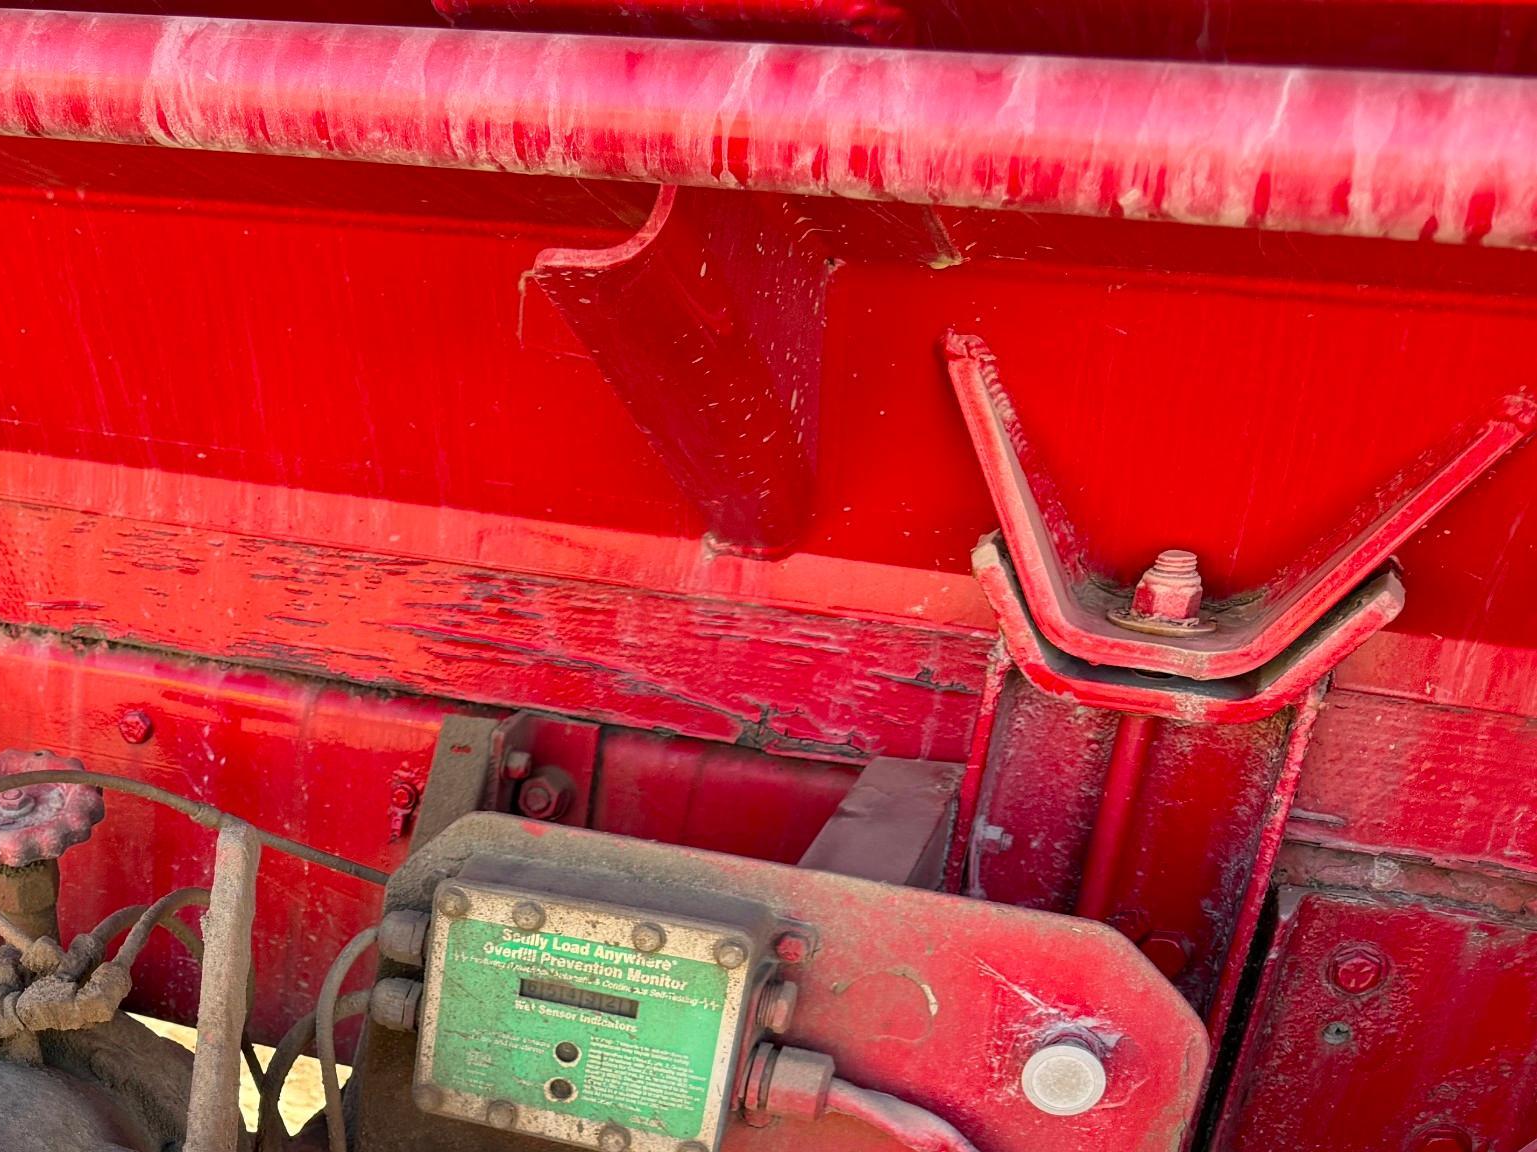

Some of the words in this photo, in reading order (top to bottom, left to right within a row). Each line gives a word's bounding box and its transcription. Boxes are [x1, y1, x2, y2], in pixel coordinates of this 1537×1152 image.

[502, 928, 548, 951] Scully
[552, 936, 591, 957] Load
[483, 941, 538, 963] Overfill
[540, 951, 624, 979] Prevention
[627, 967, 689, 991] Monitor
[538, 1004, 577, 1021] Sensor
[579, 1013, 639, 1033] Indicators
